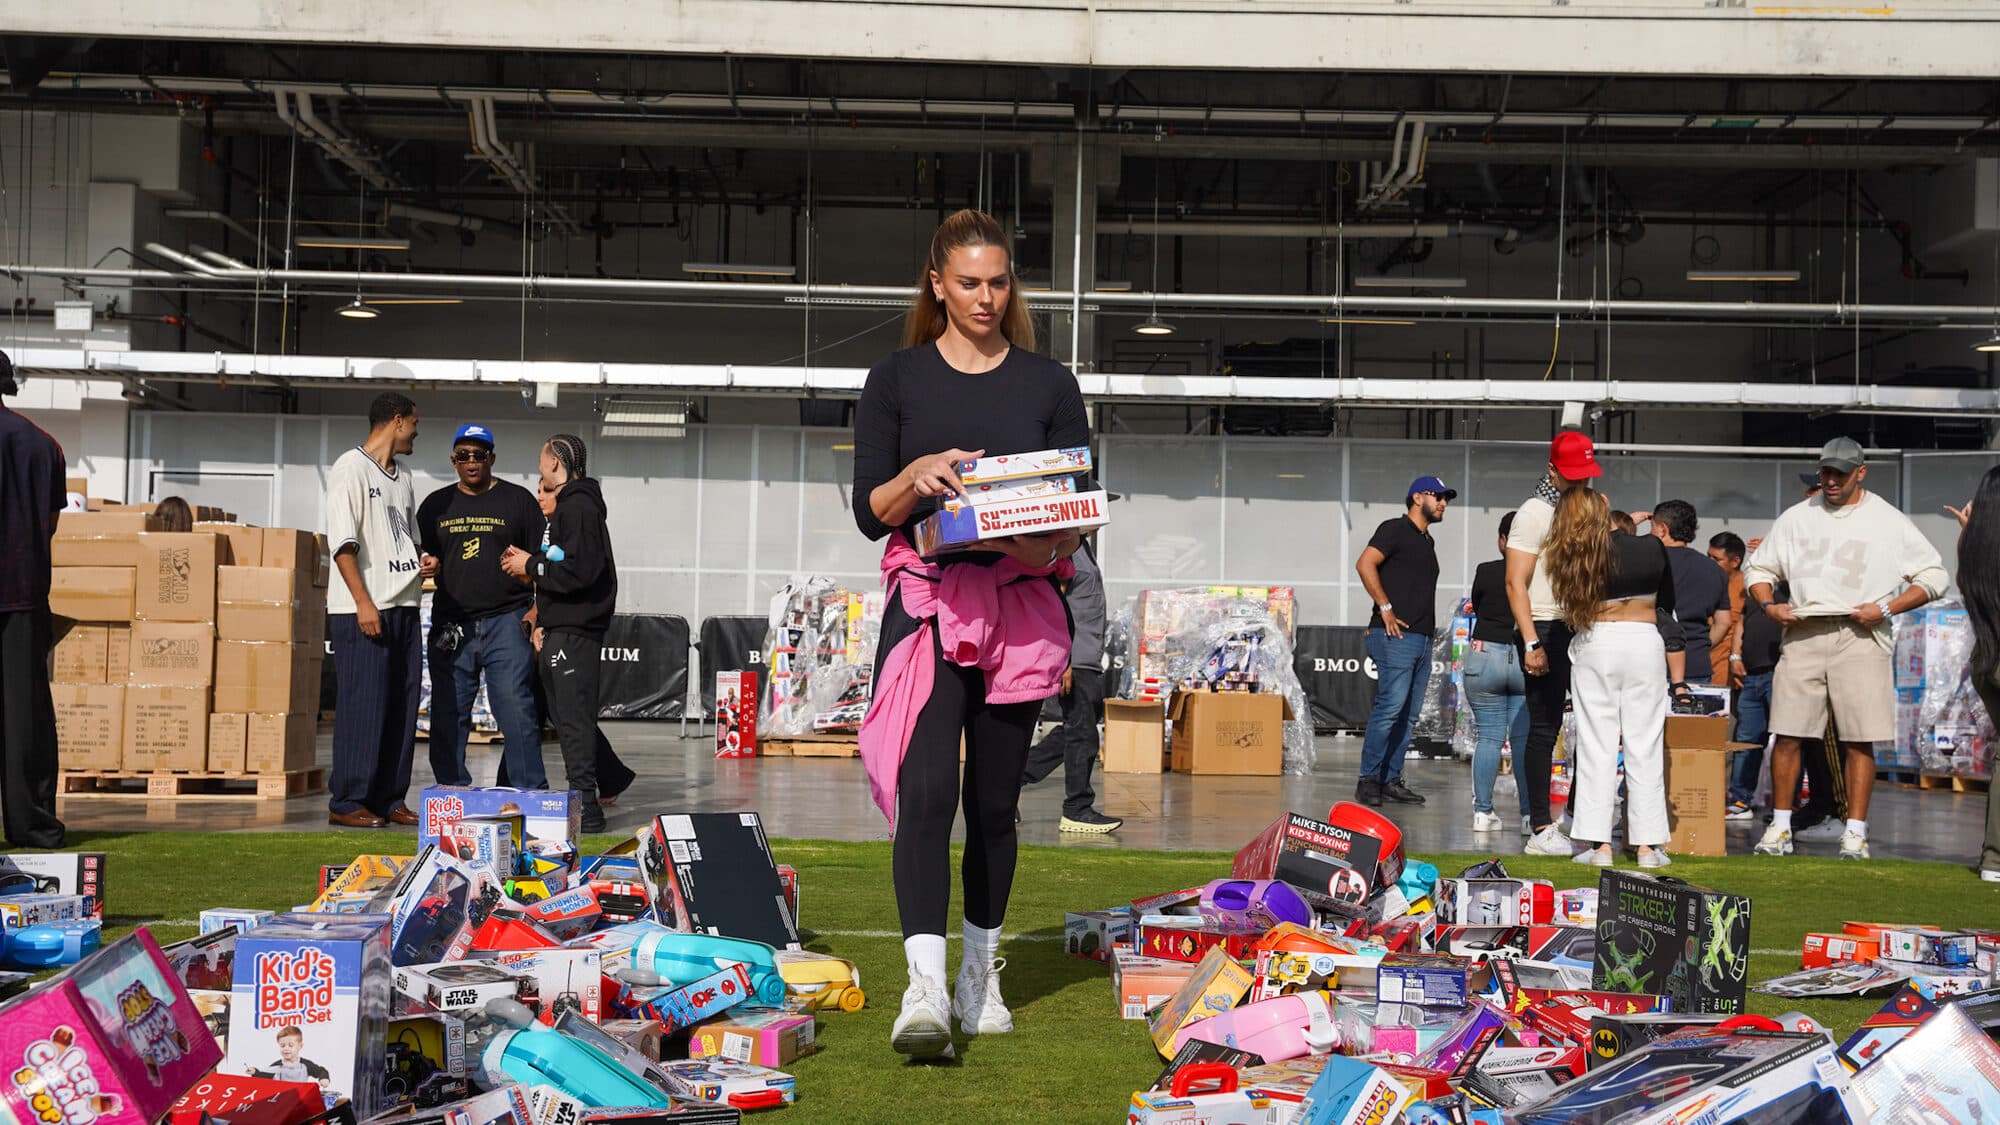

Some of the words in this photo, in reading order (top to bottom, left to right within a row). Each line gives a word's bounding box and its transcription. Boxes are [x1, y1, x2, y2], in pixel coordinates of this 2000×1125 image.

[369, 487, 381, 498] 24
[440, 518, 464, 528] MAKING
[466, 516, 505, 526] BASKETBALL
[449, 525, 470, 533] GREAT
[1314, 658, 1360, 673] BMO
[429, 795, 463, 813] Kid's
[1291, 815, 1318, 832] MIKE
[1318, 823, 1352, 841] TYSON
[1285, 843, 1299, 854] SET
[1287, 836, 1329, 855] PUNCHING
[1329, 850, 1346, 860] BAG
[1289, 826, 1313, 840] KID'S
[1313, 835, 1349, 852] BOXING
[541, 893, 580, 913] TUMBLER
[562, 897, 591, 914] VENOM
[1618, 892, 1676, 926] STRIKER-X
[1627, 916, 1653, 931] CAMERA
[1653, 923, 1677, 937] DRONE
[261, 949, 334, 985] Kid's
[261, 977, 333, 1013] Band
[446, 988, 478, 999] STAR
[446, 997, 478, 1007] WARS
[260, 1012, 303, 1030] Drum
[306, 1009, 332, 1025] Set
[1451, 1049, 1465, 1062] 3+
[59, 1048, 98, 1096] ICE
[27, 1041, 96, 1125] CREAM
[196, 1084, 281, 1103] TYSO
[175, 1096, 253, 1113] MIKE
